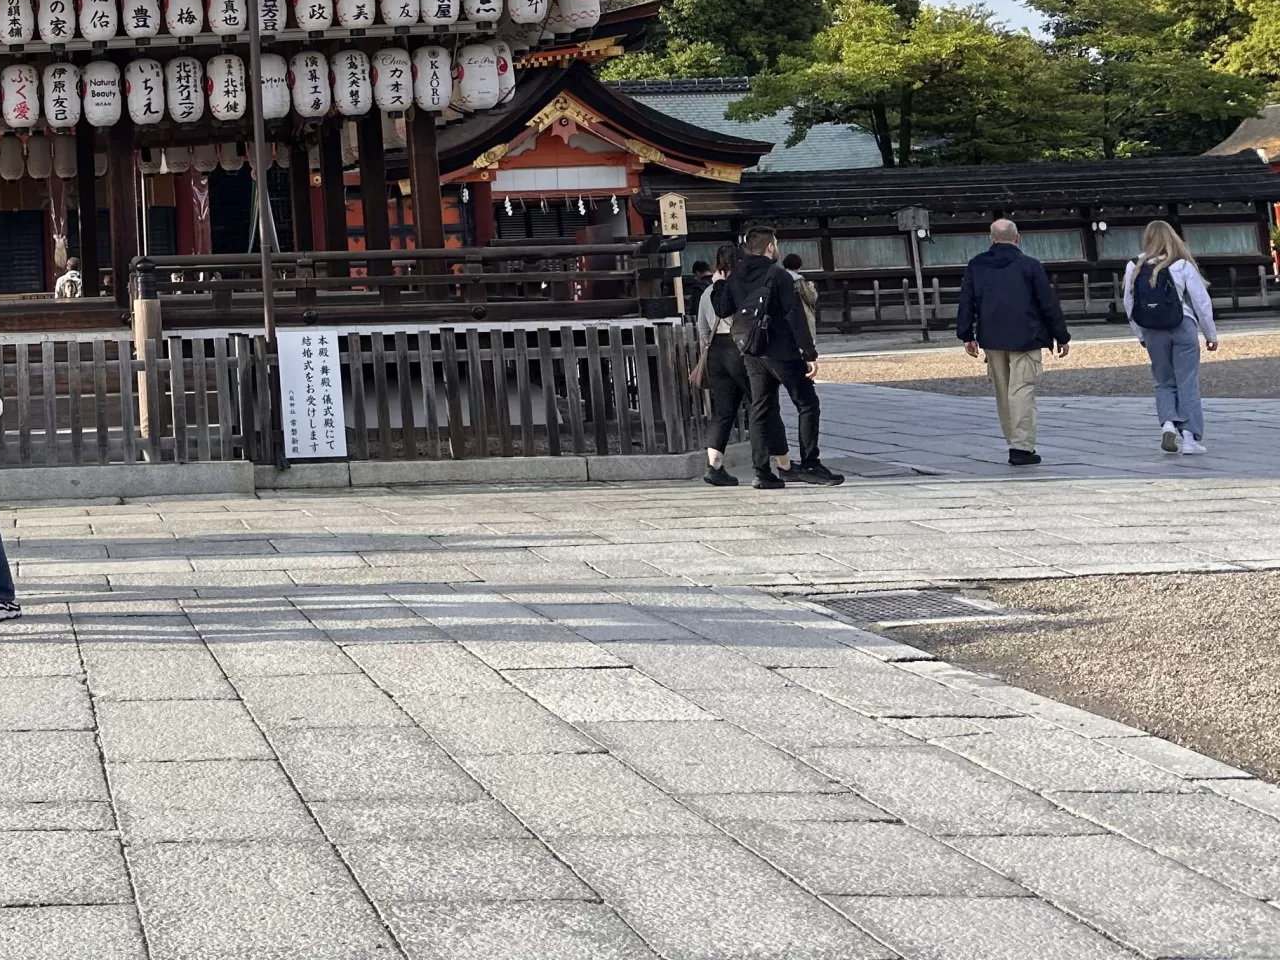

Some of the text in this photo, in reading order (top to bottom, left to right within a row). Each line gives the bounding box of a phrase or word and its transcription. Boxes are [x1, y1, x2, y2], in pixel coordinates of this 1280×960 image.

[11, 70, 31, 120] ふく愛
[51, 68, 68, 120] 伊原友己
[90, 79, 116, 87] Natural
[92, 90, 116, 99] Beauty
[139, 63, 159, 116] いちえ
[176, 61, 195, 119] 北村クリニック
[224, 78, 239, 113] 北村健
[390, 67, 404, 105] カオス
[430, 61, 440, 105] KAORU
[669, 201, 679, 230] 御本殿
[302, 336, 319, 452] 結婚式をお受けします
